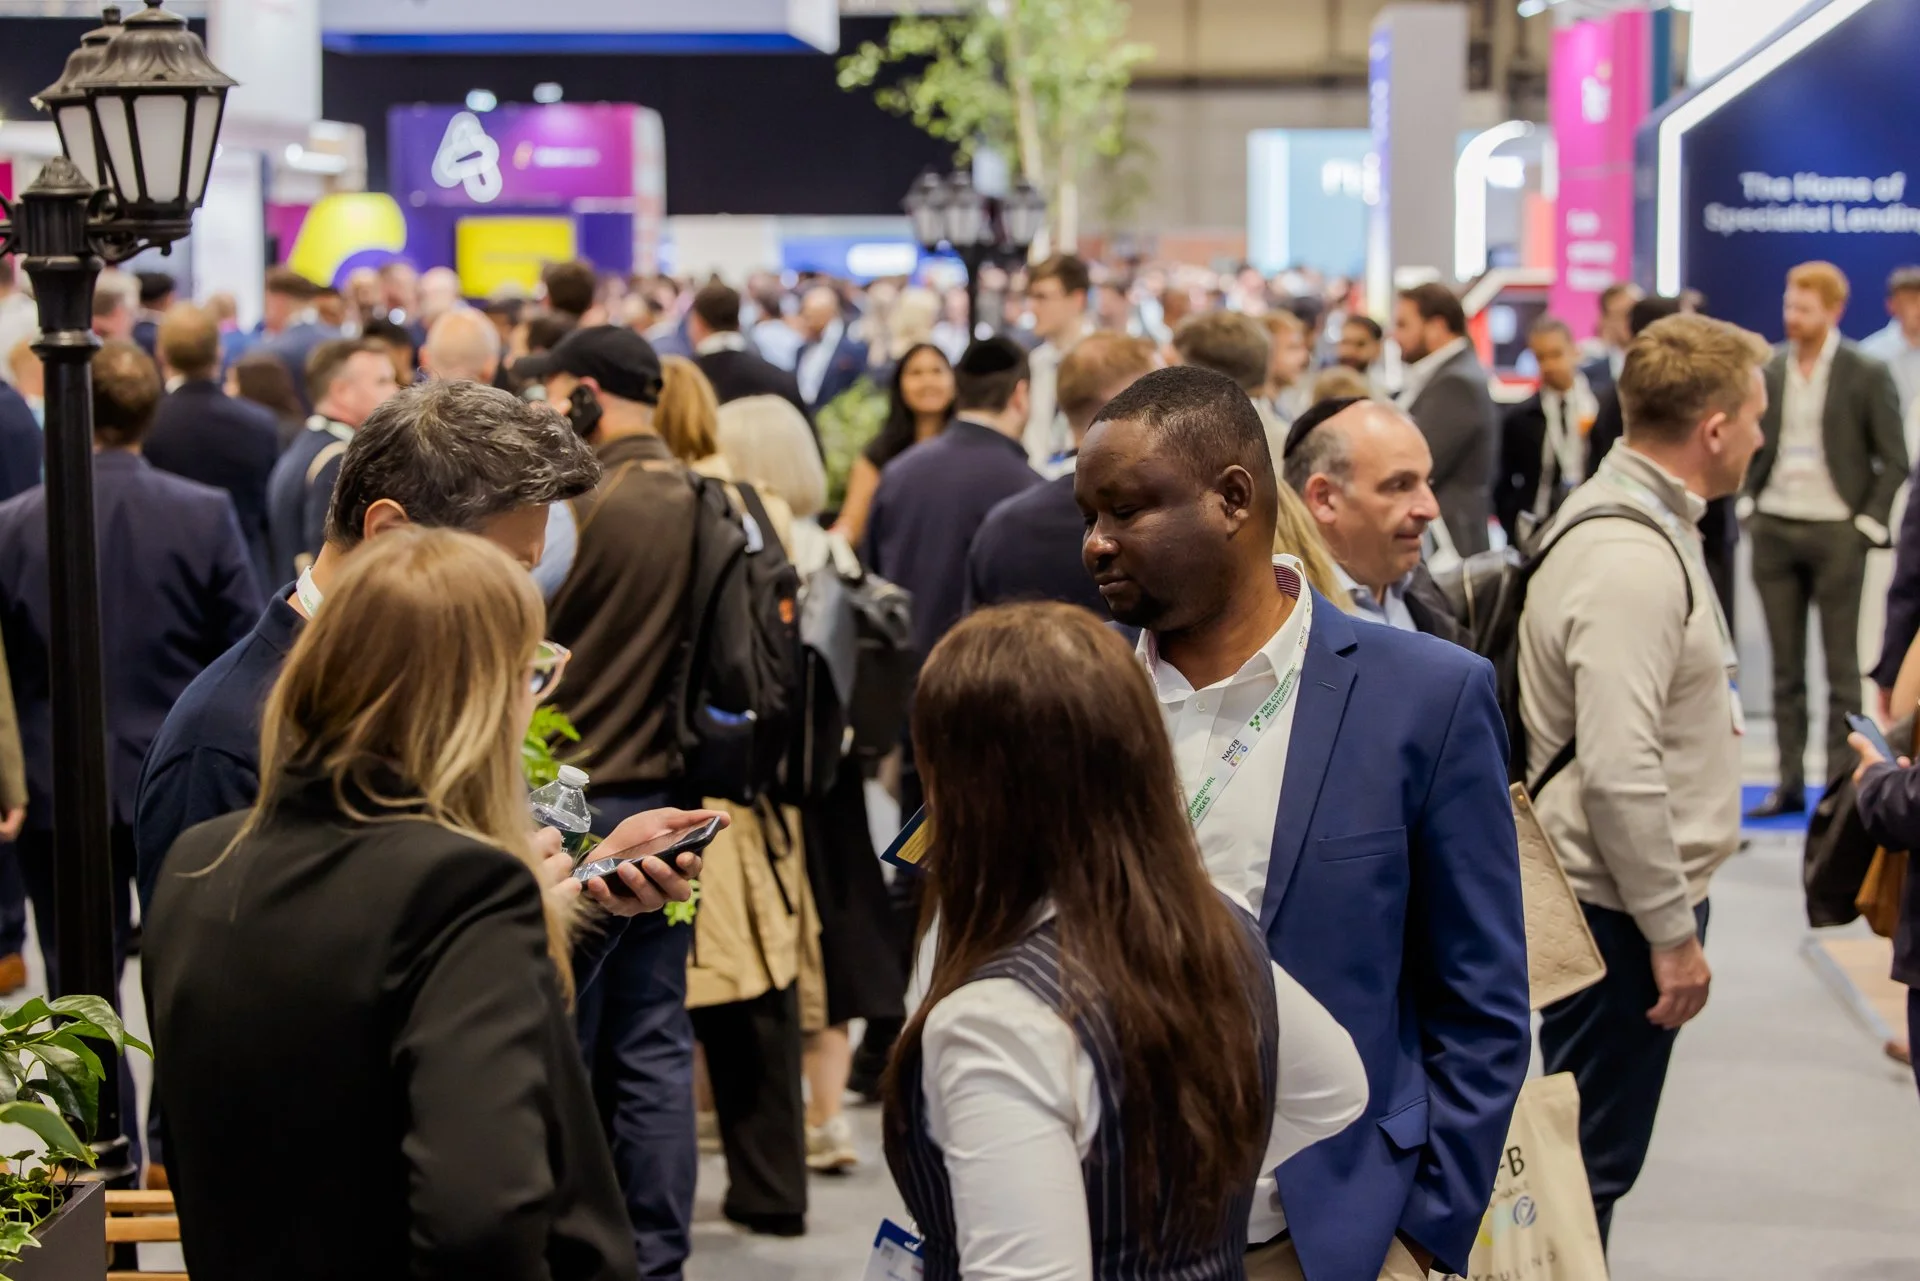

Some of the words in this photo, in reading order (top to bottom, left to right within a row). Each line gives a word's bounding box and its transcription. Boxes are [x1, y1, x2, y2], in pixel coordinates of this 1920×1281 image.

[1740, 171, 1793, 201] The
[1794, 171, 1872, 202] Home
[1873, 171, 1906, 202] of
[1703, 202, 1831, 236] Specialist
[1832, 202, 1920, 234] Lendin
[1260, 701, 1272, 714] YBS
[1264, 681, 1292, 719] MORTGAGES
[1221, 739, 1240, 761] NACFB
[1188, 776, 1216, 814] OMMERCIAL
